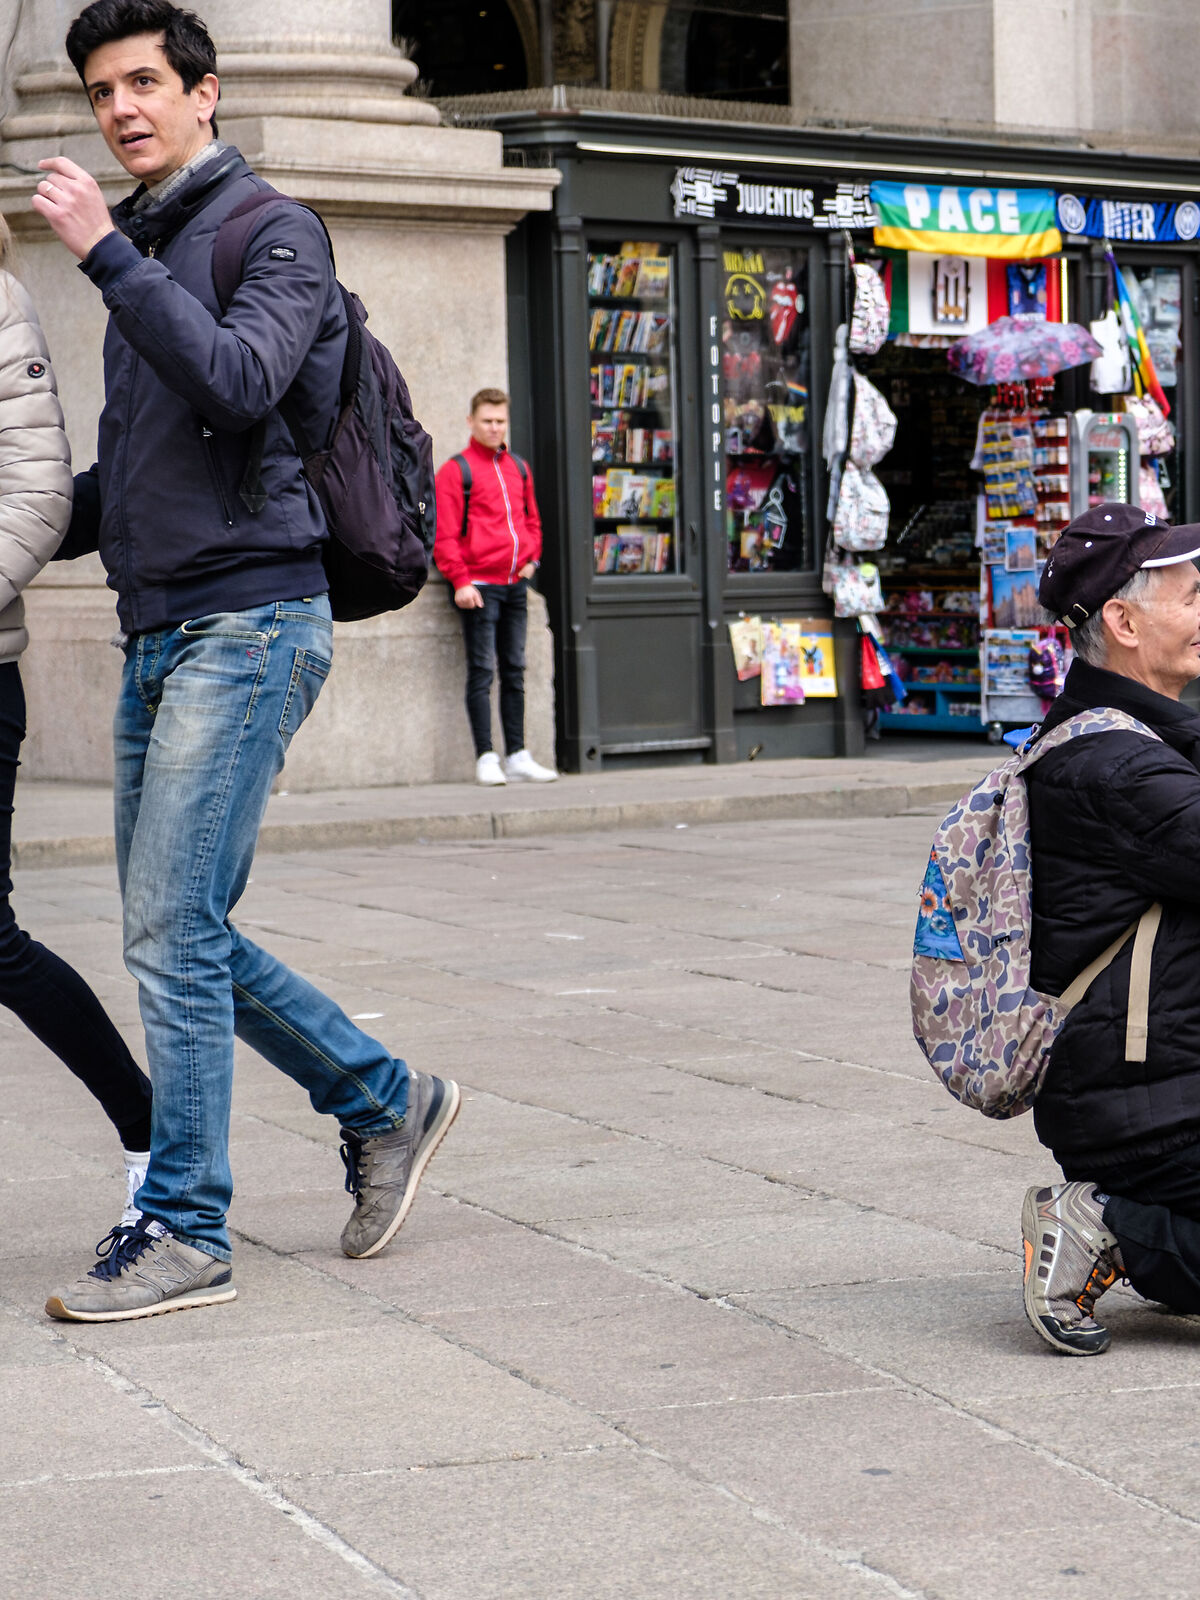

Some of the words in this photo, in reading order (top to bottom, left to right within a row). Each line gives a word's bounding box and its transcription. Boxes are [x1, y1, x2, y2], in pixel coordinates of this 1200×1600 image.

[736, 183, 815, 219] JUVENTUS
[903, 185, 1020, 233] PACE
[1102, 200, 1156, 240] INTER
